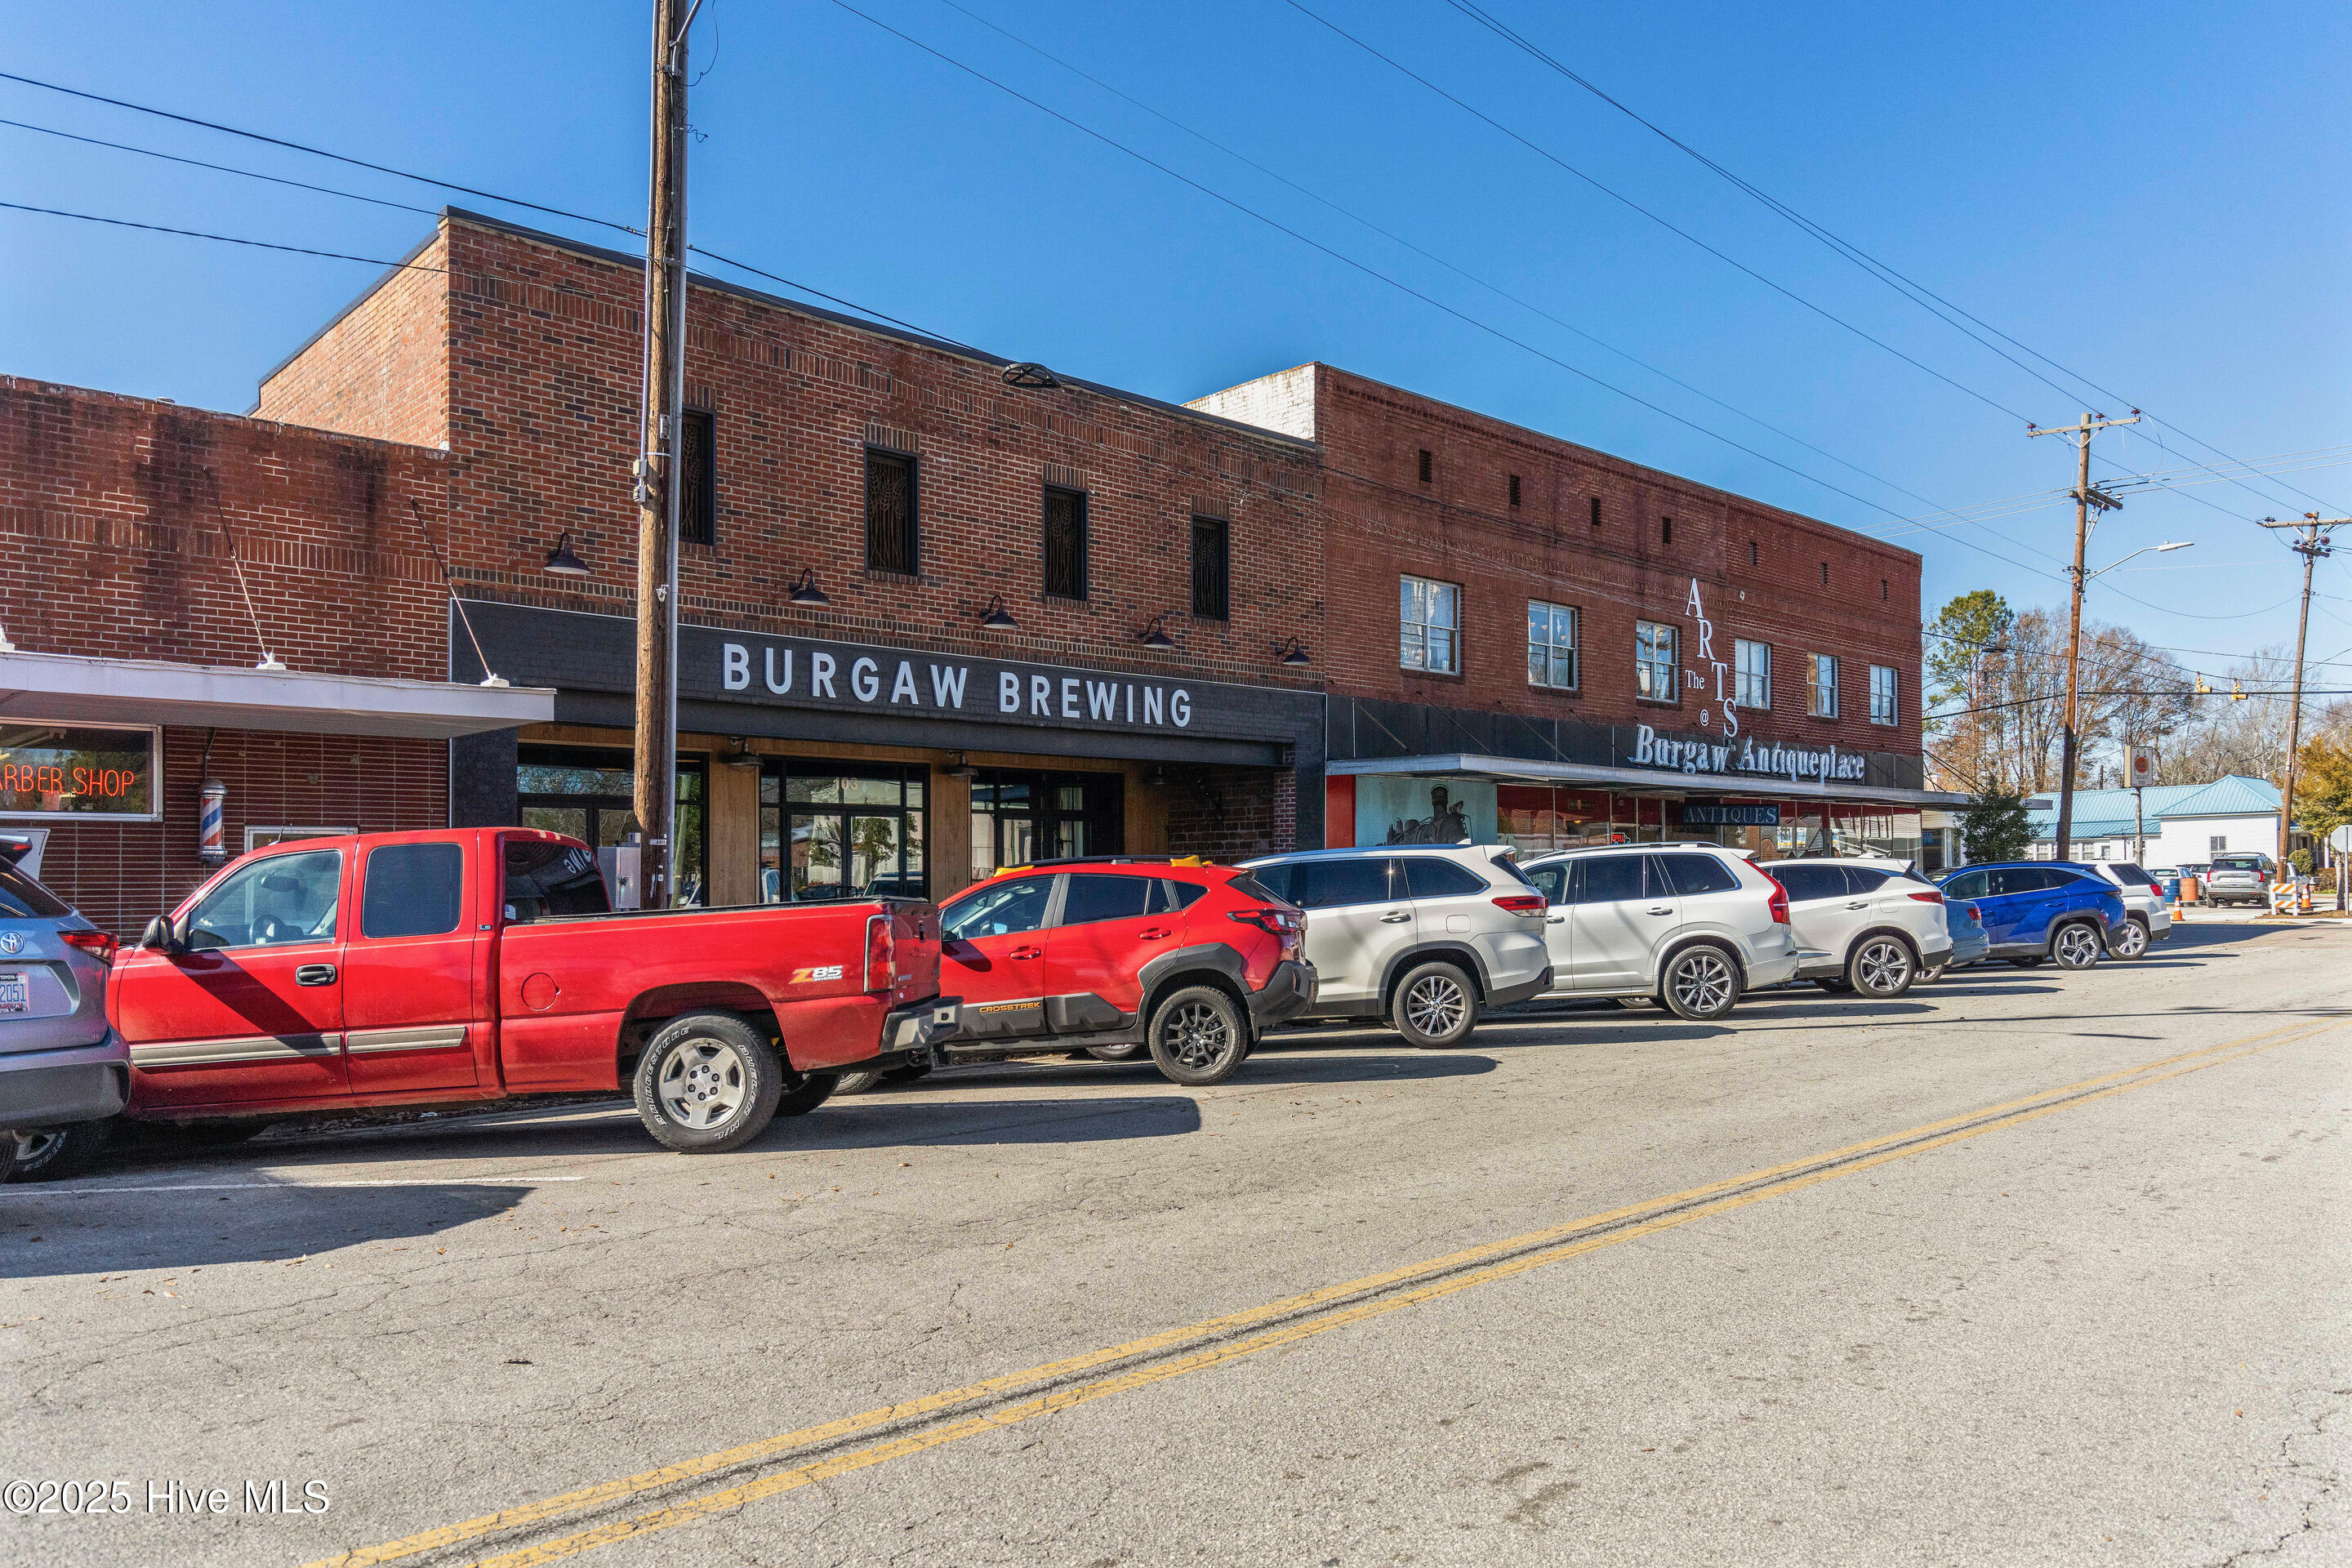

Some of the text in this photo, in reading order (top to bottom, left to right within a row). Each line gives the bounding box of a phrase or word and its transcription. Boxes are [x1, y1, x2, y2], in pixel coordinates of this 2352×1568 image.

[1685, 577, 1739, 737] ARTS
[723, 642, 1192, 728] BURGAW BREWING
[1685, 670, 1705, 689] The
[1633, 724, 1865, 784] Burgaw Antiqueplace
[0, 764, 135, 796] RBER SHOP
[834, 777, 858, 791] 103
[1685, 806, 1778, 824] ANTIQUES
[788, 964, 844, 984] Z85
[0, 983, 26, 1003] 2051
[979, 1001, 1041, 1013] CROSSTREK
[646, 1027, 690, 1125] BRIDGESTONE
[737, 1045, 758, 1116] DUELER
